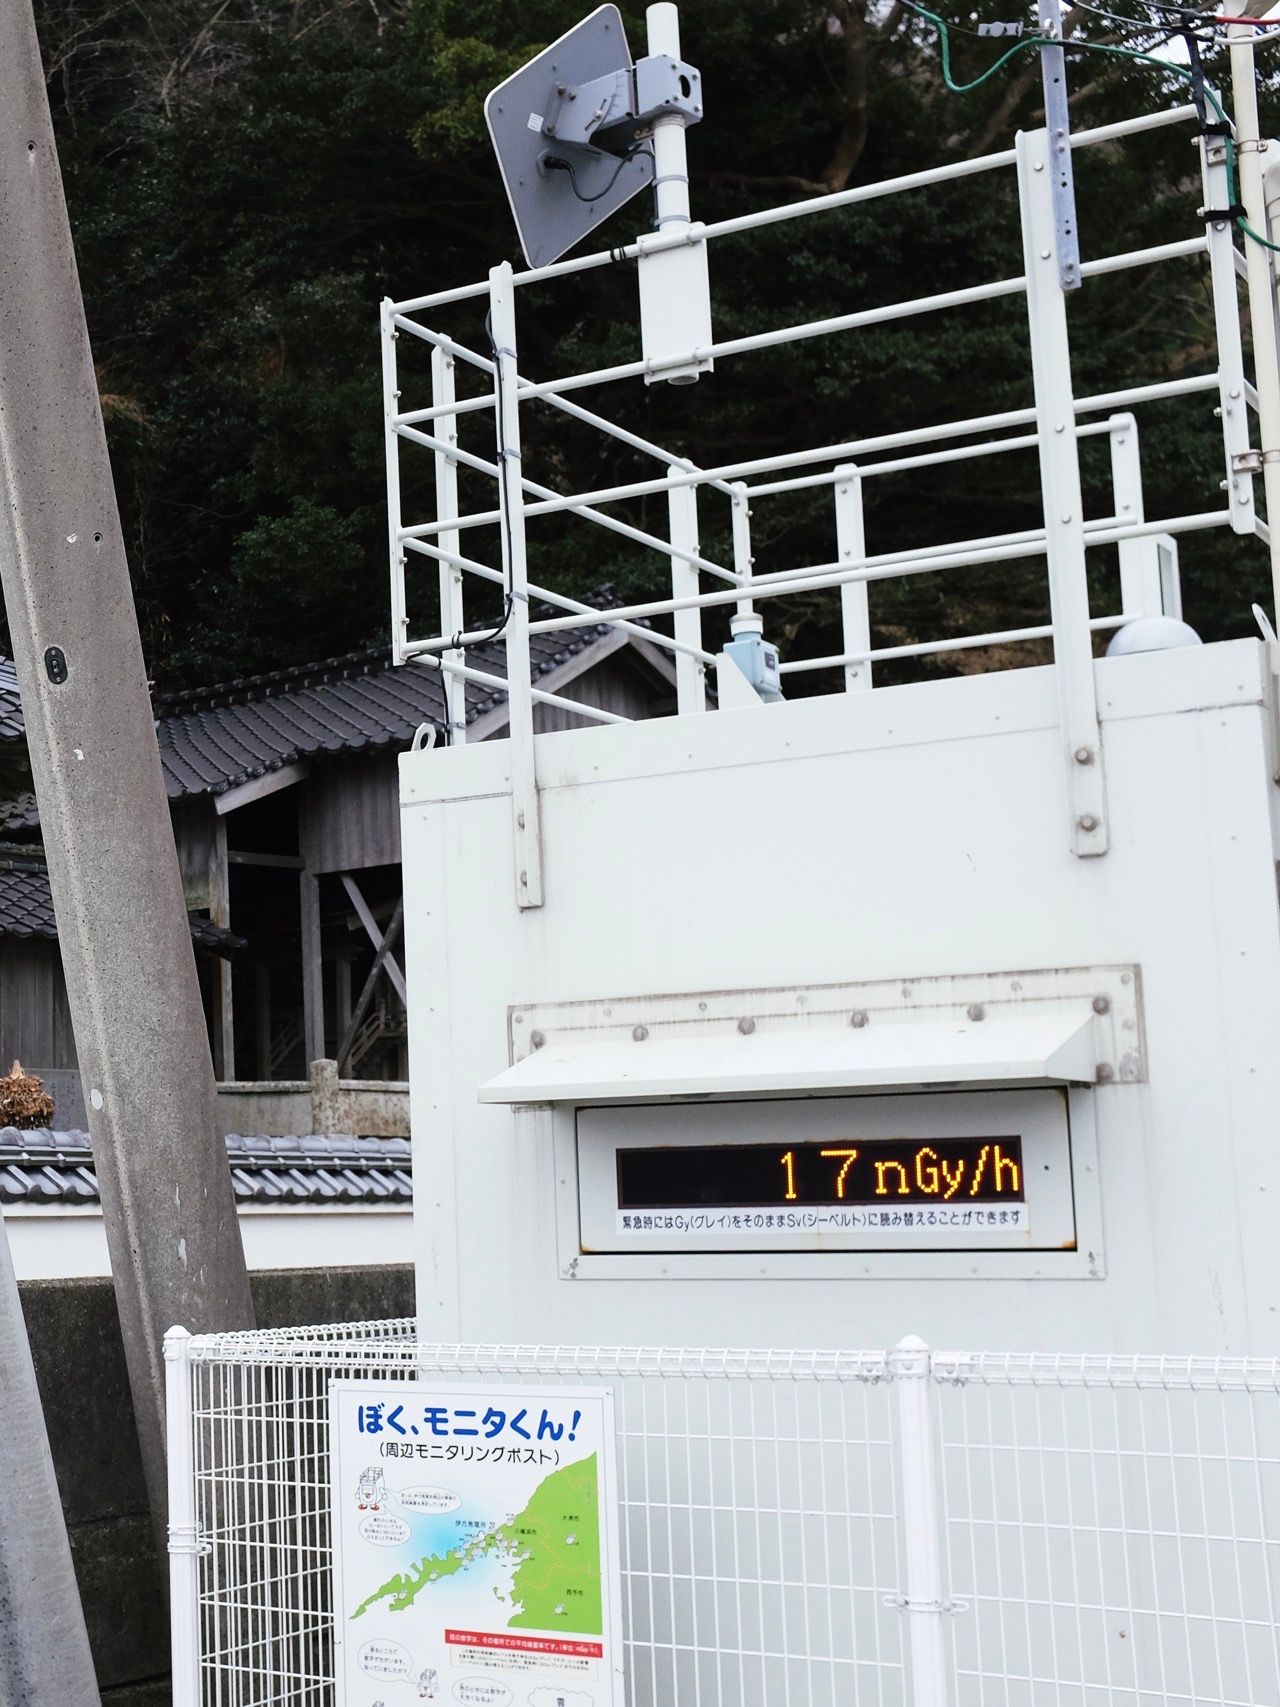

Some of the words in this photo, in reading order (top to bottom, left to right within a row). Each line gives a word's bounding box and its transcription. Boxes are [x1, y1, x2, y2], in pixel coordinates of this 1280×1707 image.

[874, 1144, 1020, 1200] nGy/h
[622, 1210, 1022, 1233] 緊急時にはGy(グレイ)をそのままSv(シーベルト)に読み替えることができます
[357, 1402, 582, 1442] ぼく、モニタくん!
[378, 1440, 561, 1466] (周辺モニタリングポスト)
